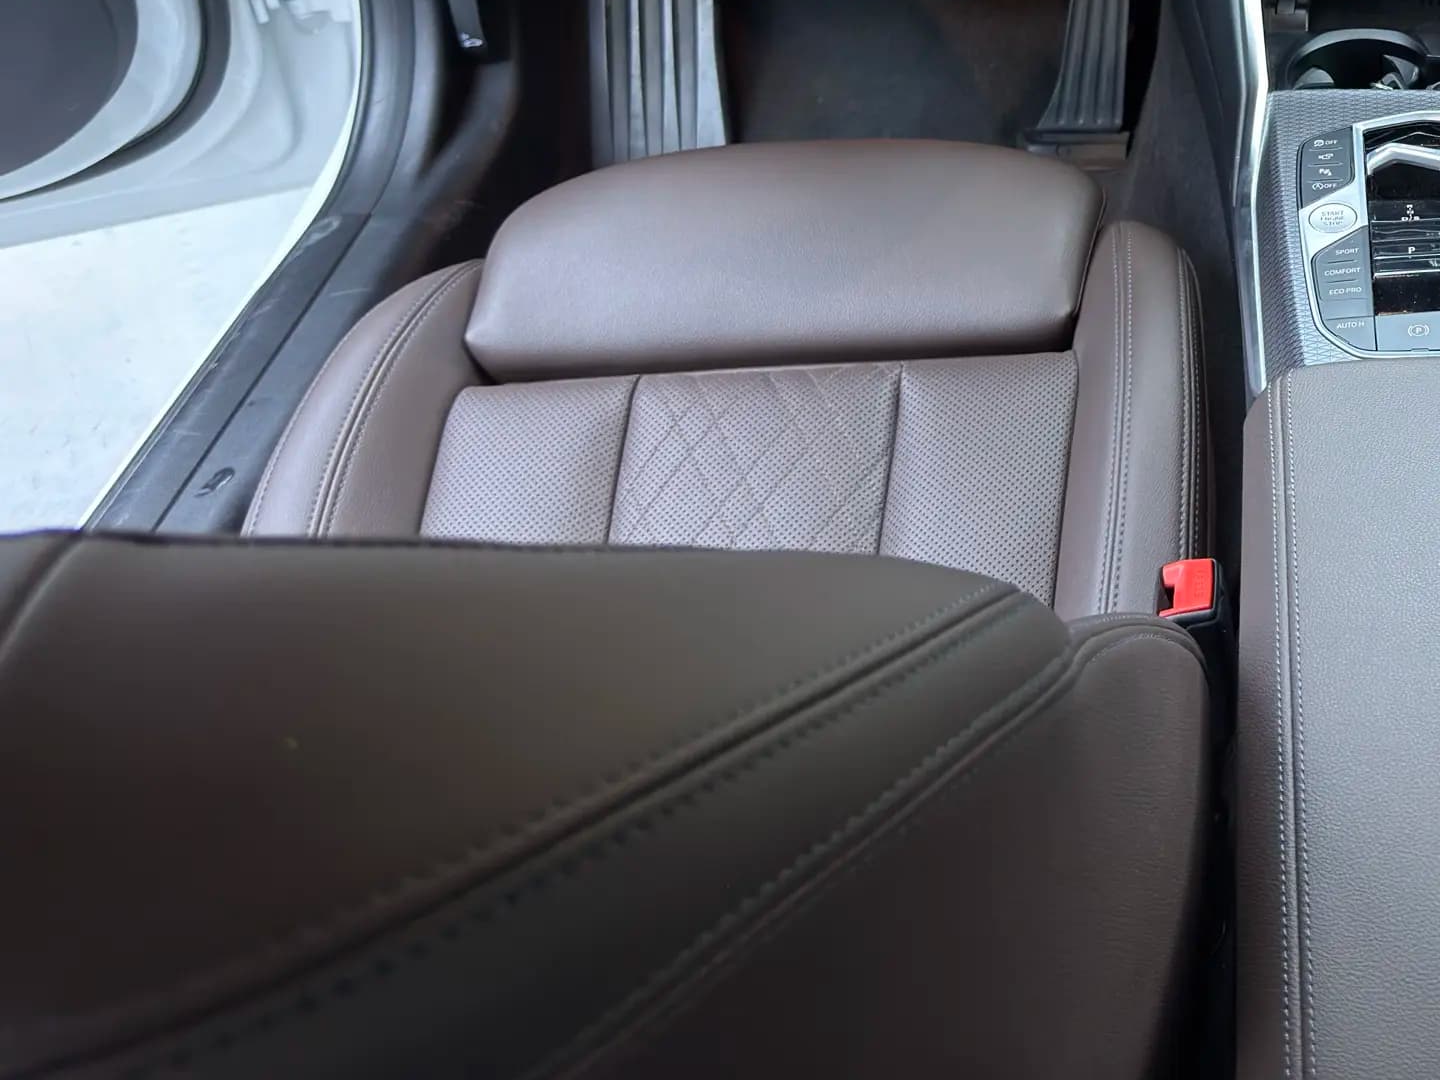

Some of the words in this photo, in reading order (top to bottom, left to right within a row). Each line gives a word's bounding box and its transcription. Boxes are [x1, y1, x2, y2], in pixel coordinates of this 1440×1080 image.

[1335, 247, 1360, 255] SPORT
[1408, 246, 1416, 255] P
[1324, 267, 1361, 276] COMFORT
[1329, 288, 1345, 296] ECO
[1345, 286, 1362, 294] PRO
[1336, 321, 1358, 329] AUTO
